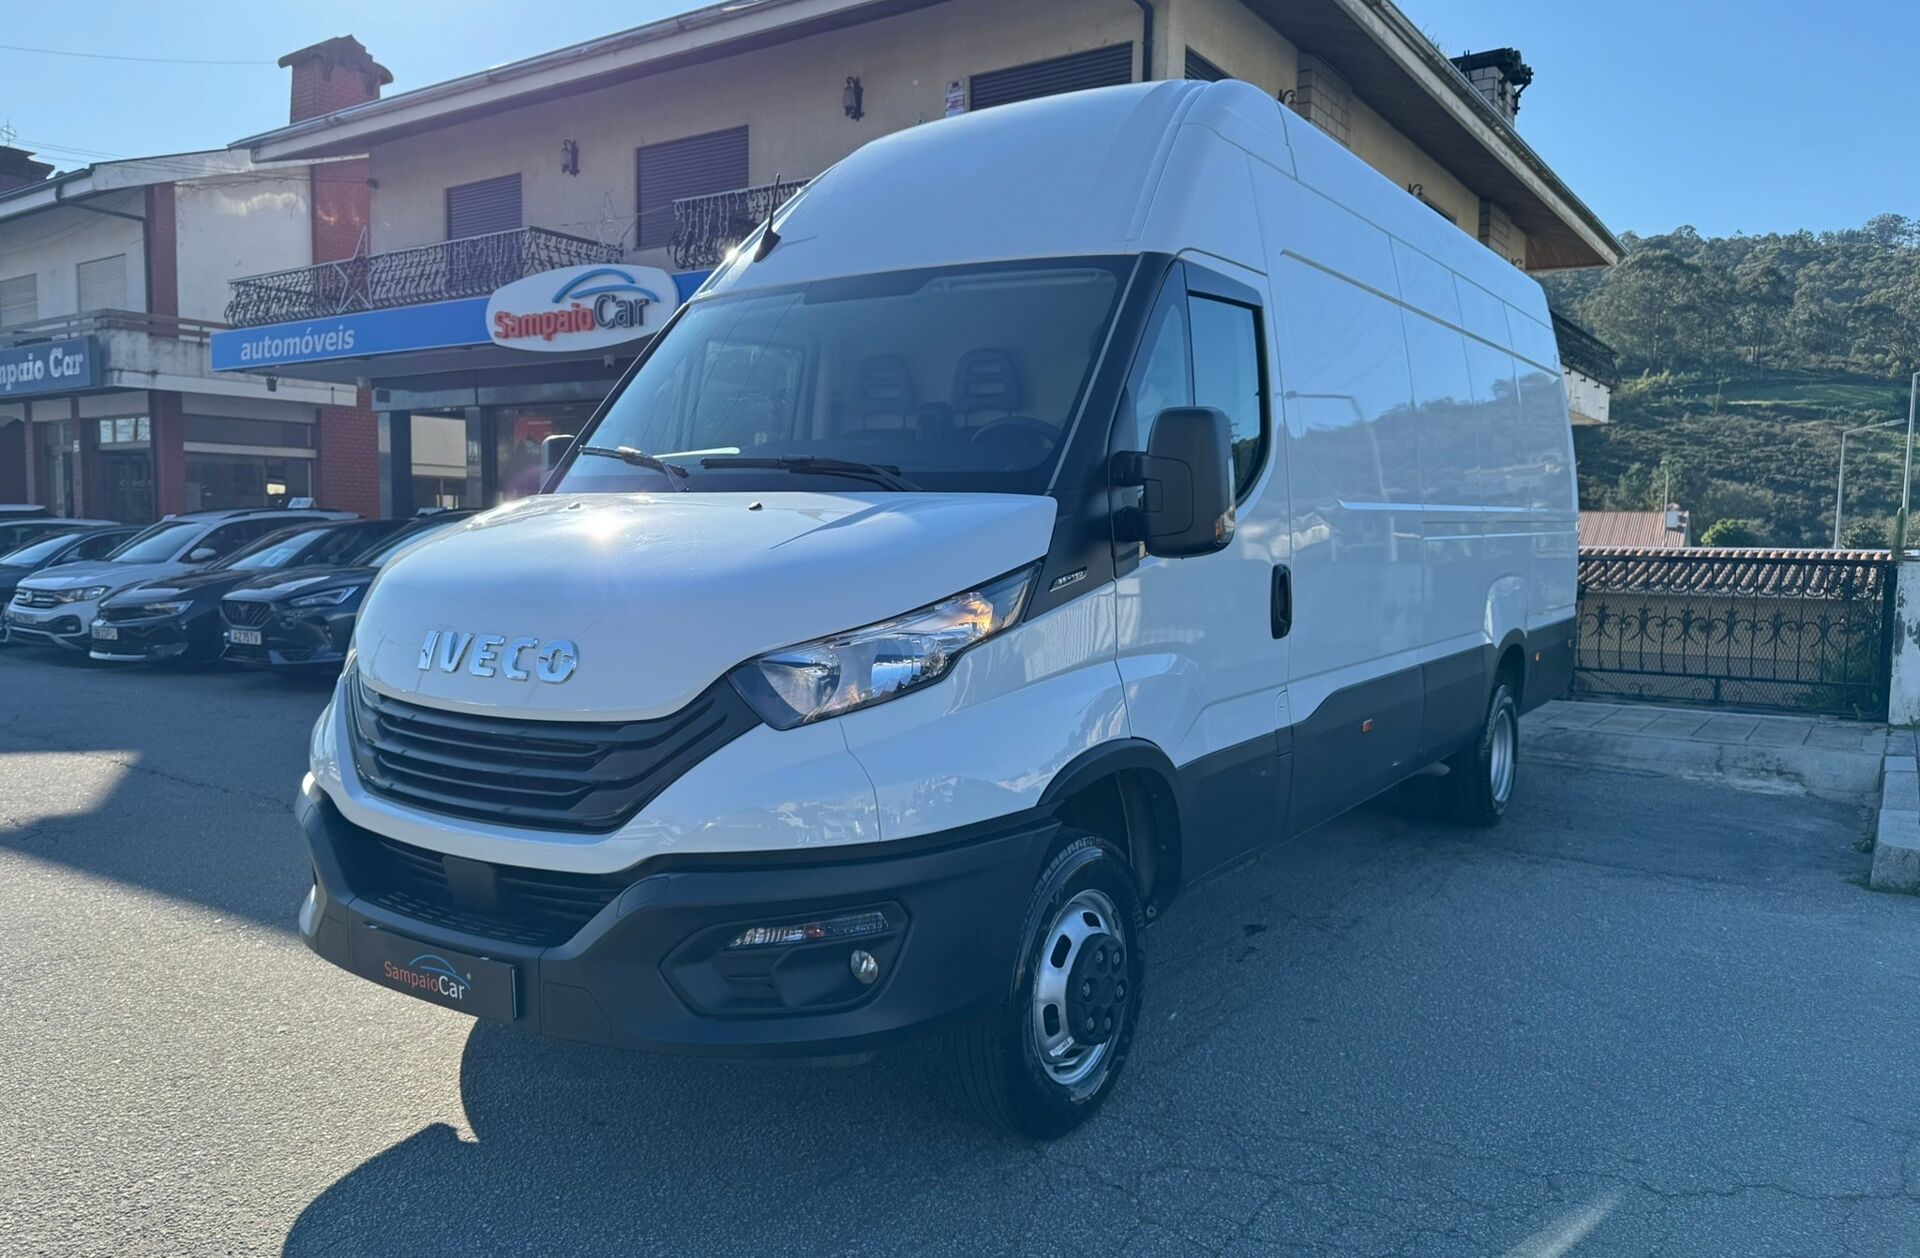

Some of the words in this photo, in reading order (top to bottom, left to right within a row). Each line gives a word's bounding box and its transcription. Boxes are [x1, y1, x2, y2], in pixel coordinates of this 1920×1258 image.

[494, 293, 649, 341] SampaioCar
[49, 347, 83, 378] Car
[240, 325, 355, 361] automóveis
[417, 630, 579, 684] IVECO
[384, 960, 466, 1001] SampaioCar
